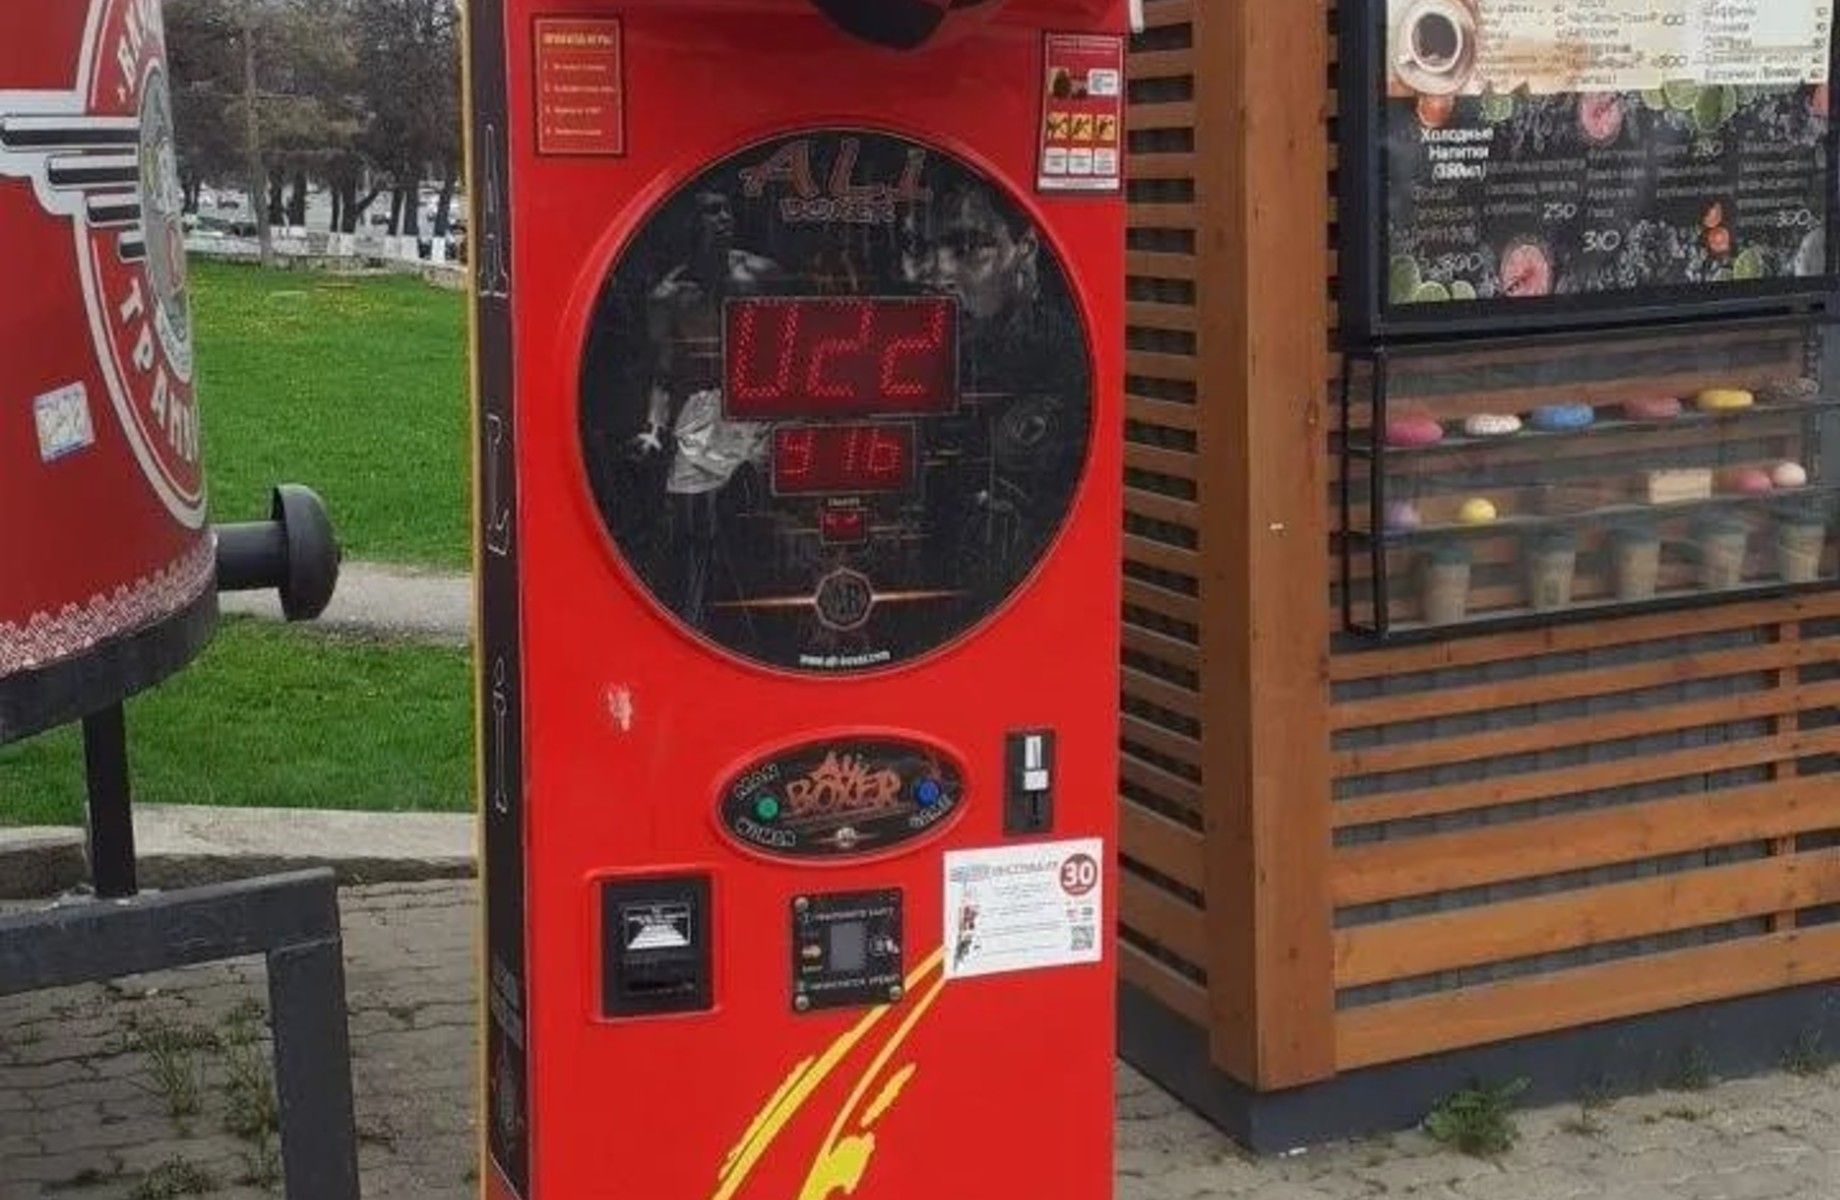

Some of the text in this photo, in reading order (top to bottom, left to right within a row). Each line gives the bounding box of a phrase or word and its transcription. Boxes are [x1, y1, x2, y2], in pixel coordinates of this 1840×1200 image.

[1420, 127, 1495, 144] Холодные
[1428, 145, 1490, 161] Напитки
[739, 139, 934, 201] ALI
[1063, 860, 1096, 887] 30
